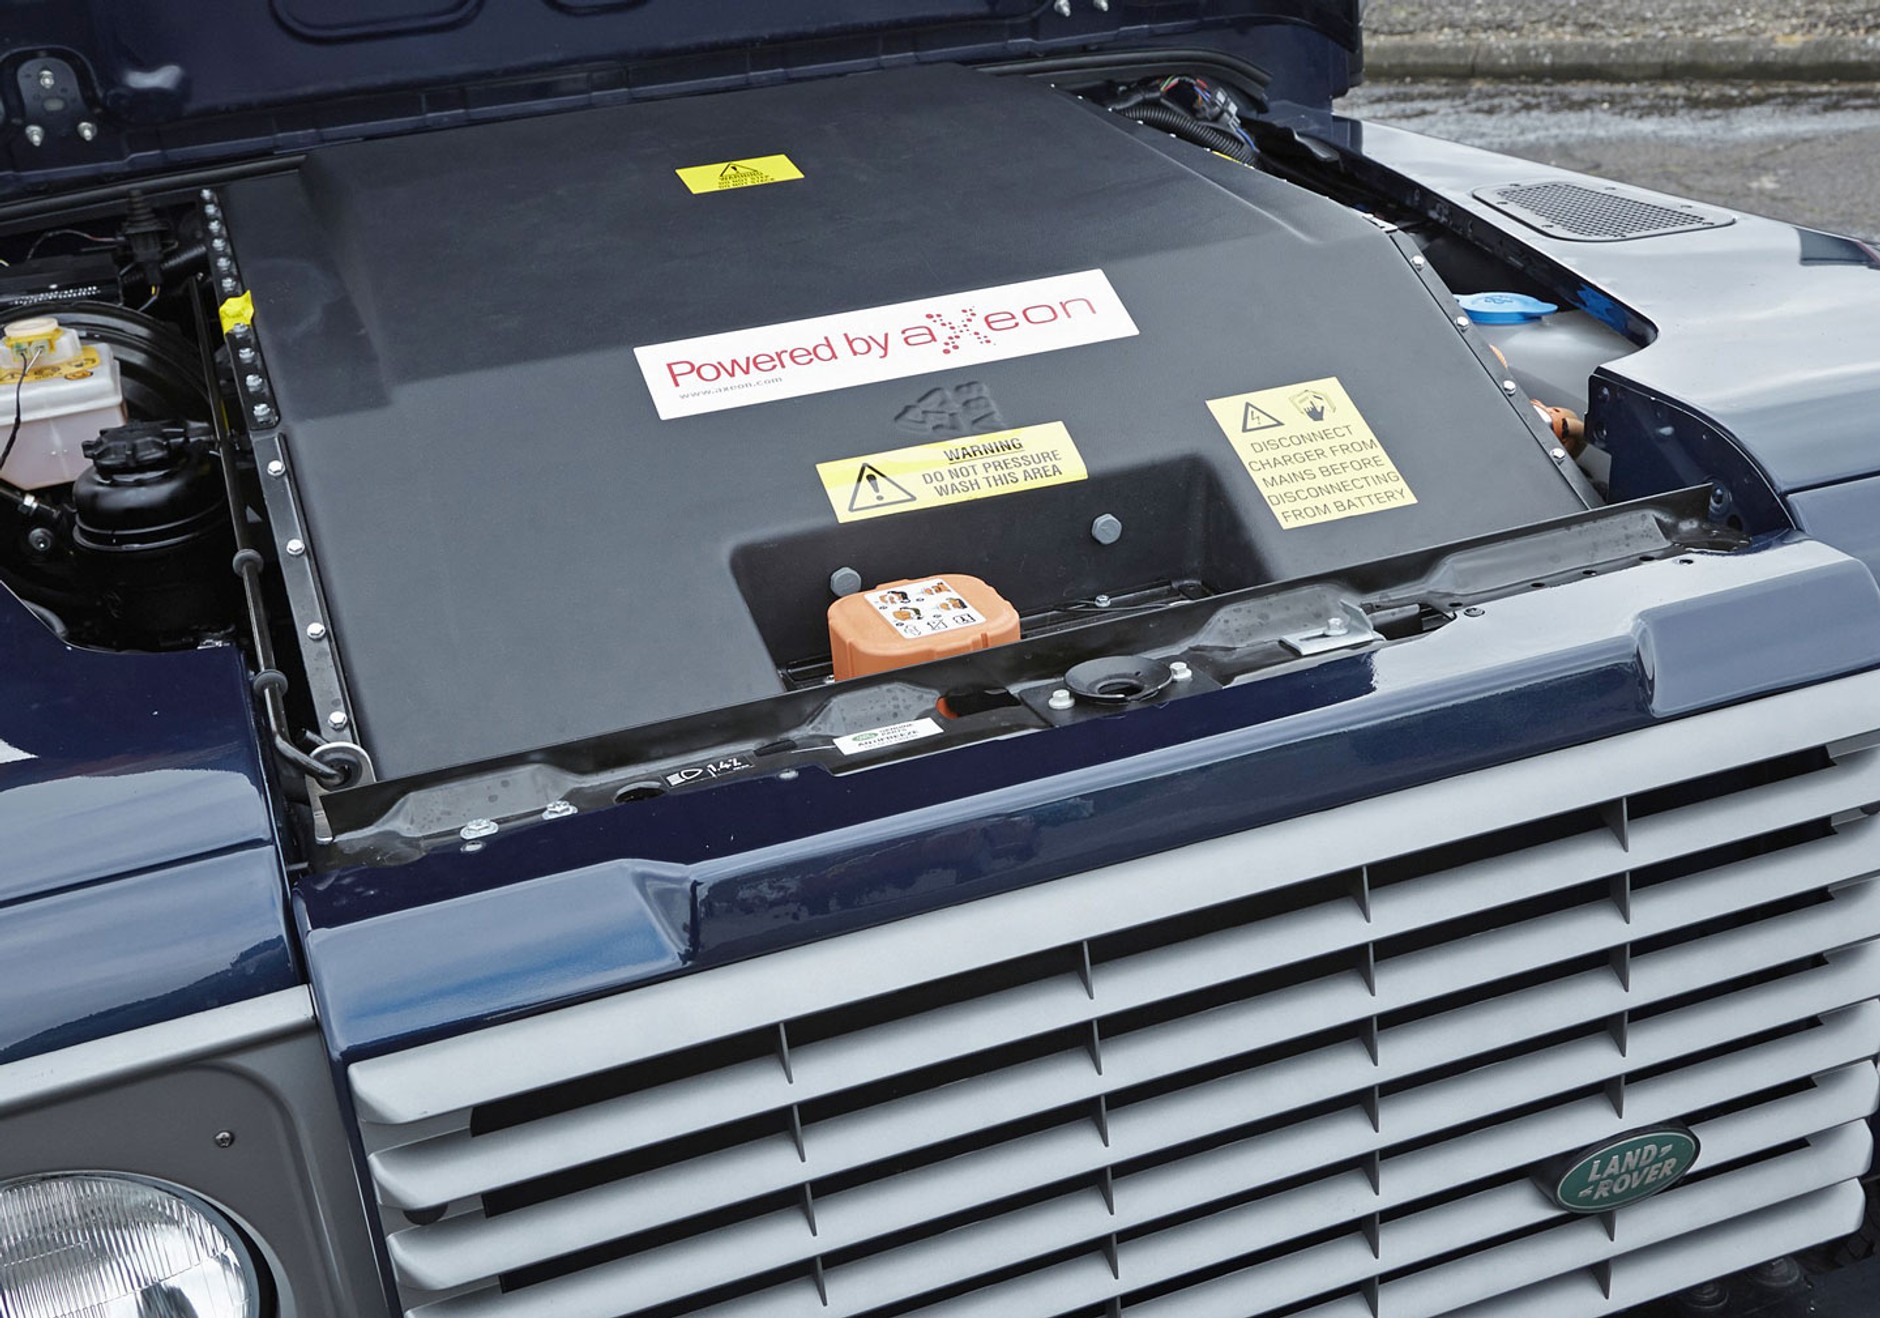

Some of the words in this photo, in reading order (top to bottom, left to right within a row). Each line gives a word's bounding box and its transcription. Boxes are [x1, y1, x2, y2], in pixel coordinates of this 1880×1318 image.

[666, 336, 838, 387] Powered
[843, 332, 889, 359] by
[679, 376, 783, 399] www.axeon.com
[944, 437, 1024, 462] WARNING
[1248, 449, 1329, 472] CHARGER
[1329, 438, 1378, 458] FROM
[1250, 424, 1354, 454] DISCONNECT
[922, 470, 945, 485] DO
[948, 464, 979, 480] NOT
[982, 449, 1062, 474] PRESSURE
[934, 476, 981, 497] WASH
[983, 471, 1020, 489] THIS
[1023, 464, 1063, 482] AREA
[1262, 468, 1316, 489] MAINS
[1318, 455, 1385, 478] BEFORE
[1266, 470, 1400, 507] DISCONNECTING
[1281, 503, 1332, 523] FROM
[1333, 488, 1406, 513] BATTERY
[1588, 1144, 1658, 1183] LAND
[1593, 1157, 1677, 1200] ROVER
